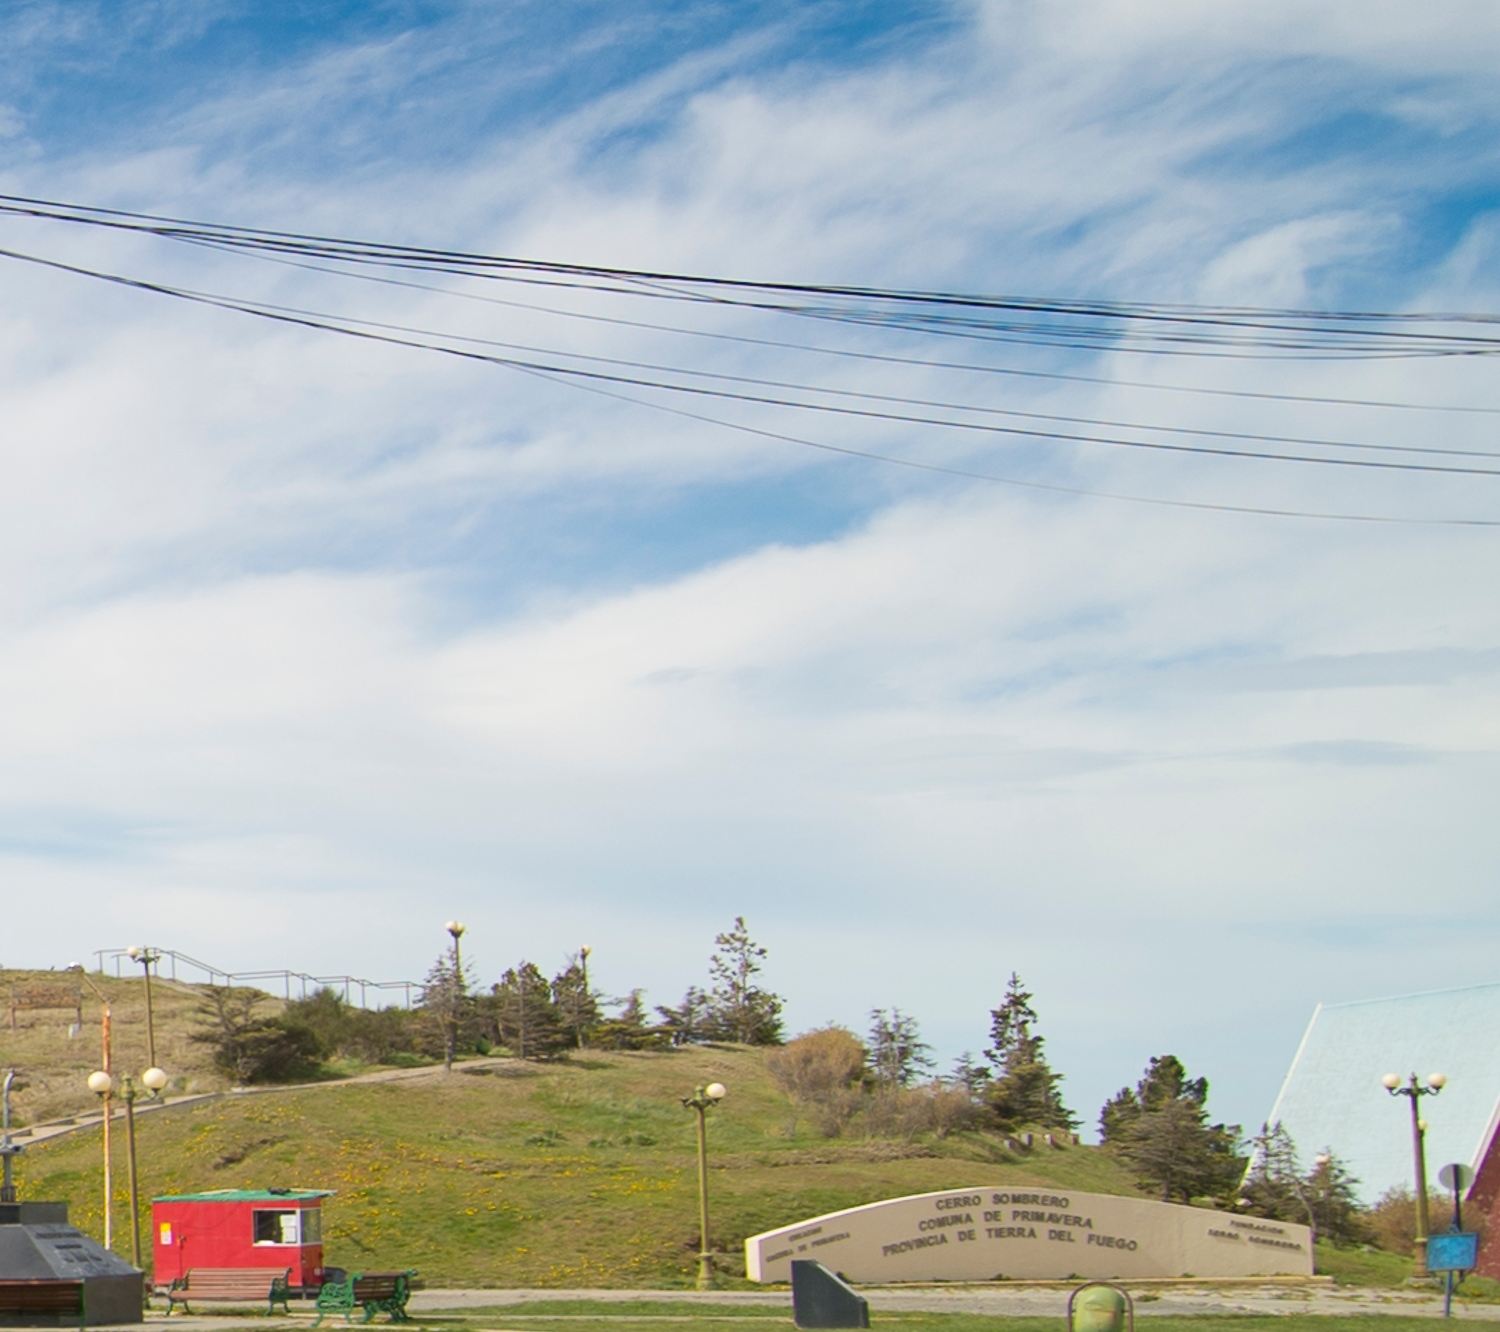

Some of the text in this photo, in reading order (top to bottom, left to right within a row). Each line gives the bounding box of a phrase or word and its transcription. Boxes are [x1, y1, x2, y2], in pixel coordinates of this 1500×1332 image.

[935, 1193, 1070, 1211] CERRO SOMBRERO
[918, 1210, 1093, 1232] COMUNA DE PRIMAVERA
[882, 1227, 1138, 1257] PROVINCIA DE TIERRA DEL FUEGO
